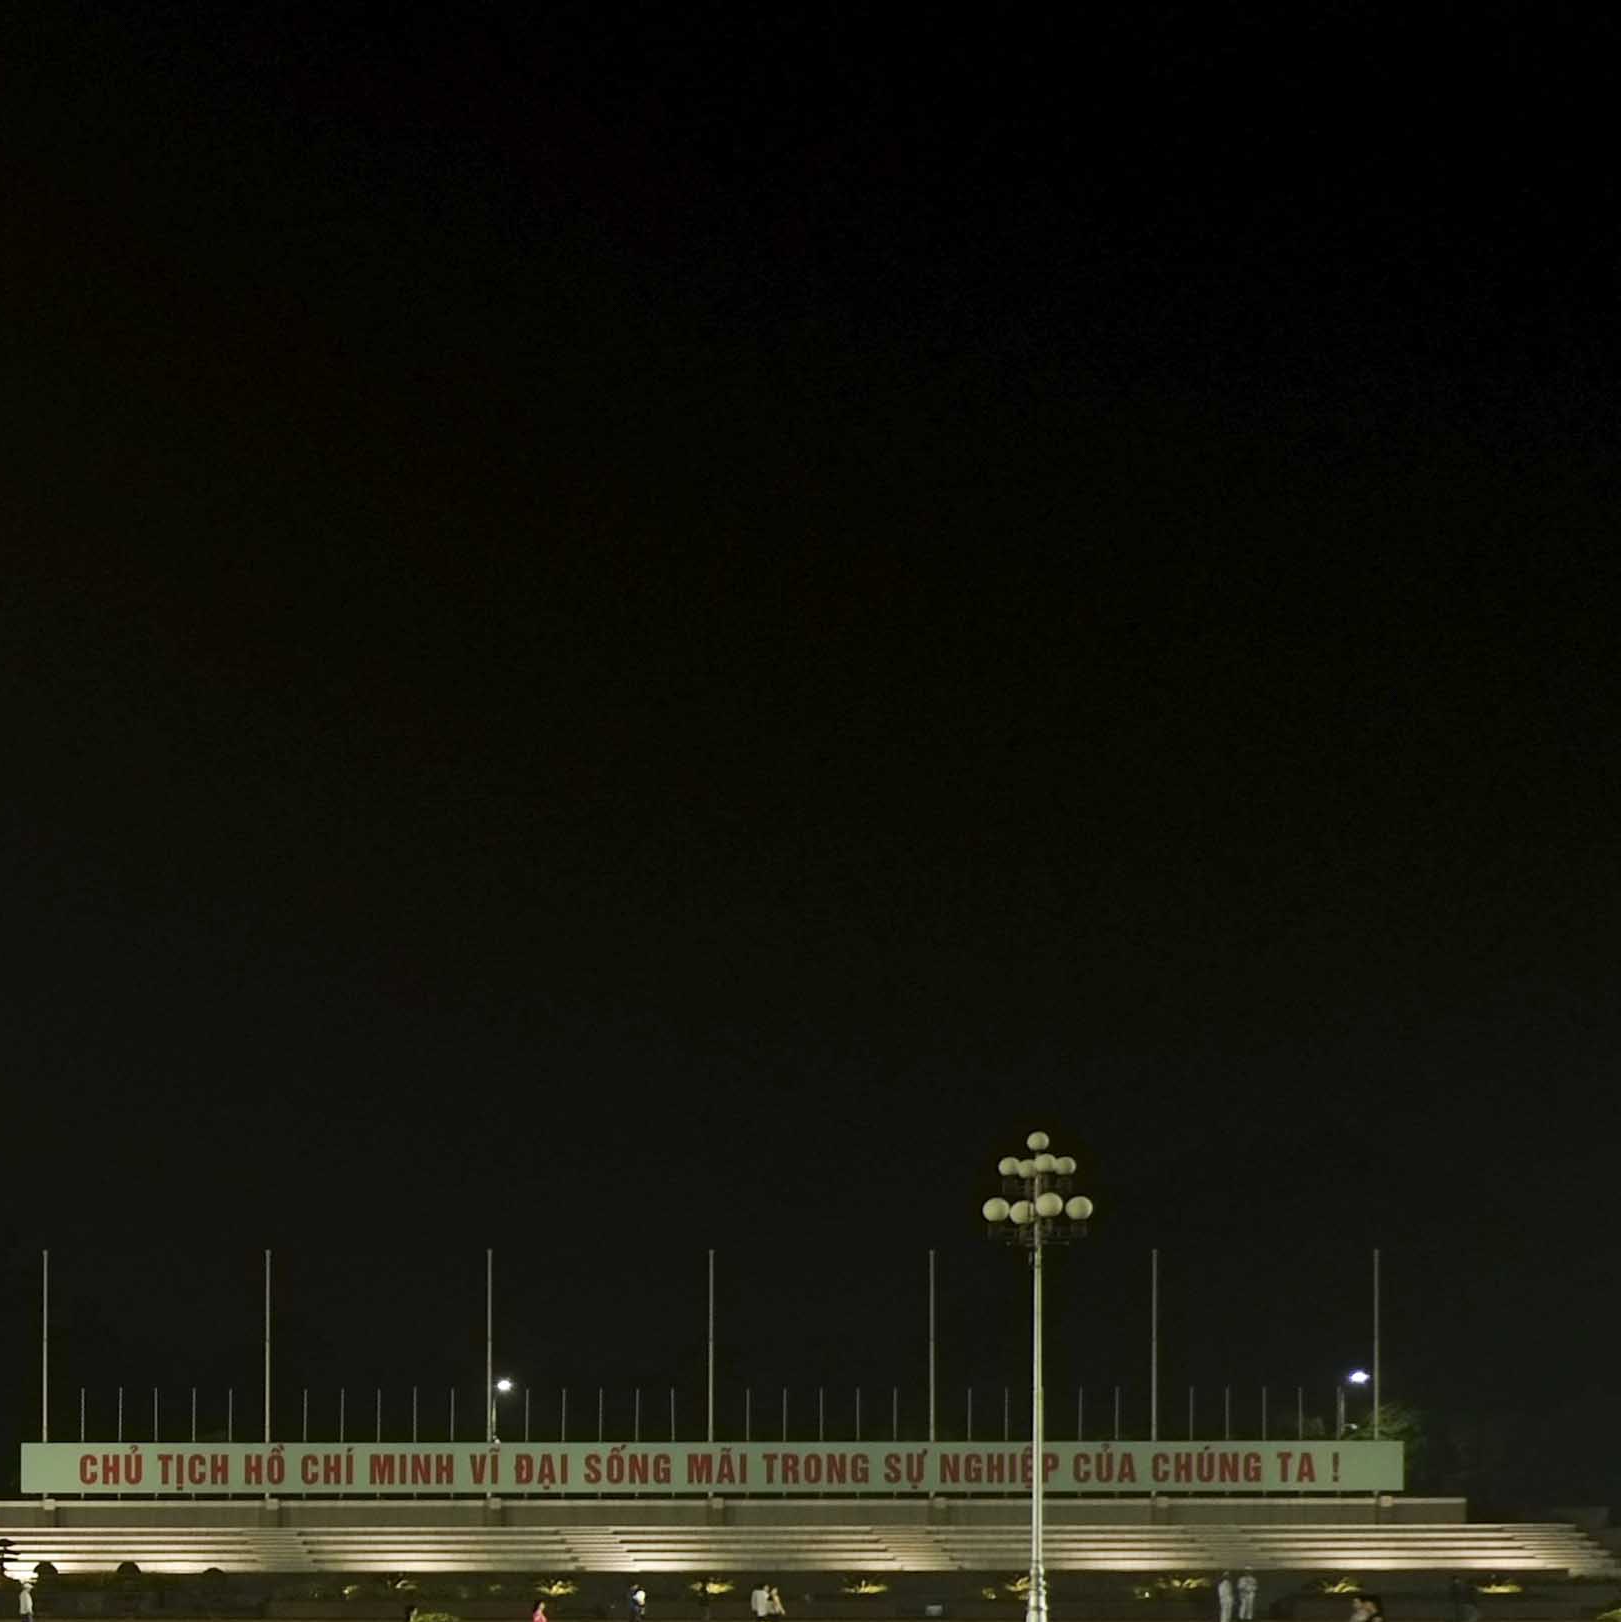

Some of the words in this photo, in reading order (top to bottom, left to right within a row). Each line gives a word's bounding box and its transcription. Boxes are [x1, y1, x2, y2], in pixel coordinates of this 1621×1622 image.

[79, 1445, 143, 1485] CHỦ
[158, 1454, 230, 1490] TỊCH
[244, 1444, 286, 1485] HỒ
[301, 1448, 354, 1485] CHÍ
[369, 1454, 454, 1485] MINH
[469, 1448, 500, 1485] VĨ
[514, 1454, 570, 1490] ĐẠI
[583, 1445, 673, 1484] SỐNG
[687, 1448, 748, 1484] MÃI
[762, 1453, 870, 1484] TRONG
[884, 1449, 927, 1489] SỰ
[1073, 1444, 1137, 1483] CỦA
[1152, 1446, 1262, 1483] CHÚNG
[1277, 1452, 1316, 1483] TA
